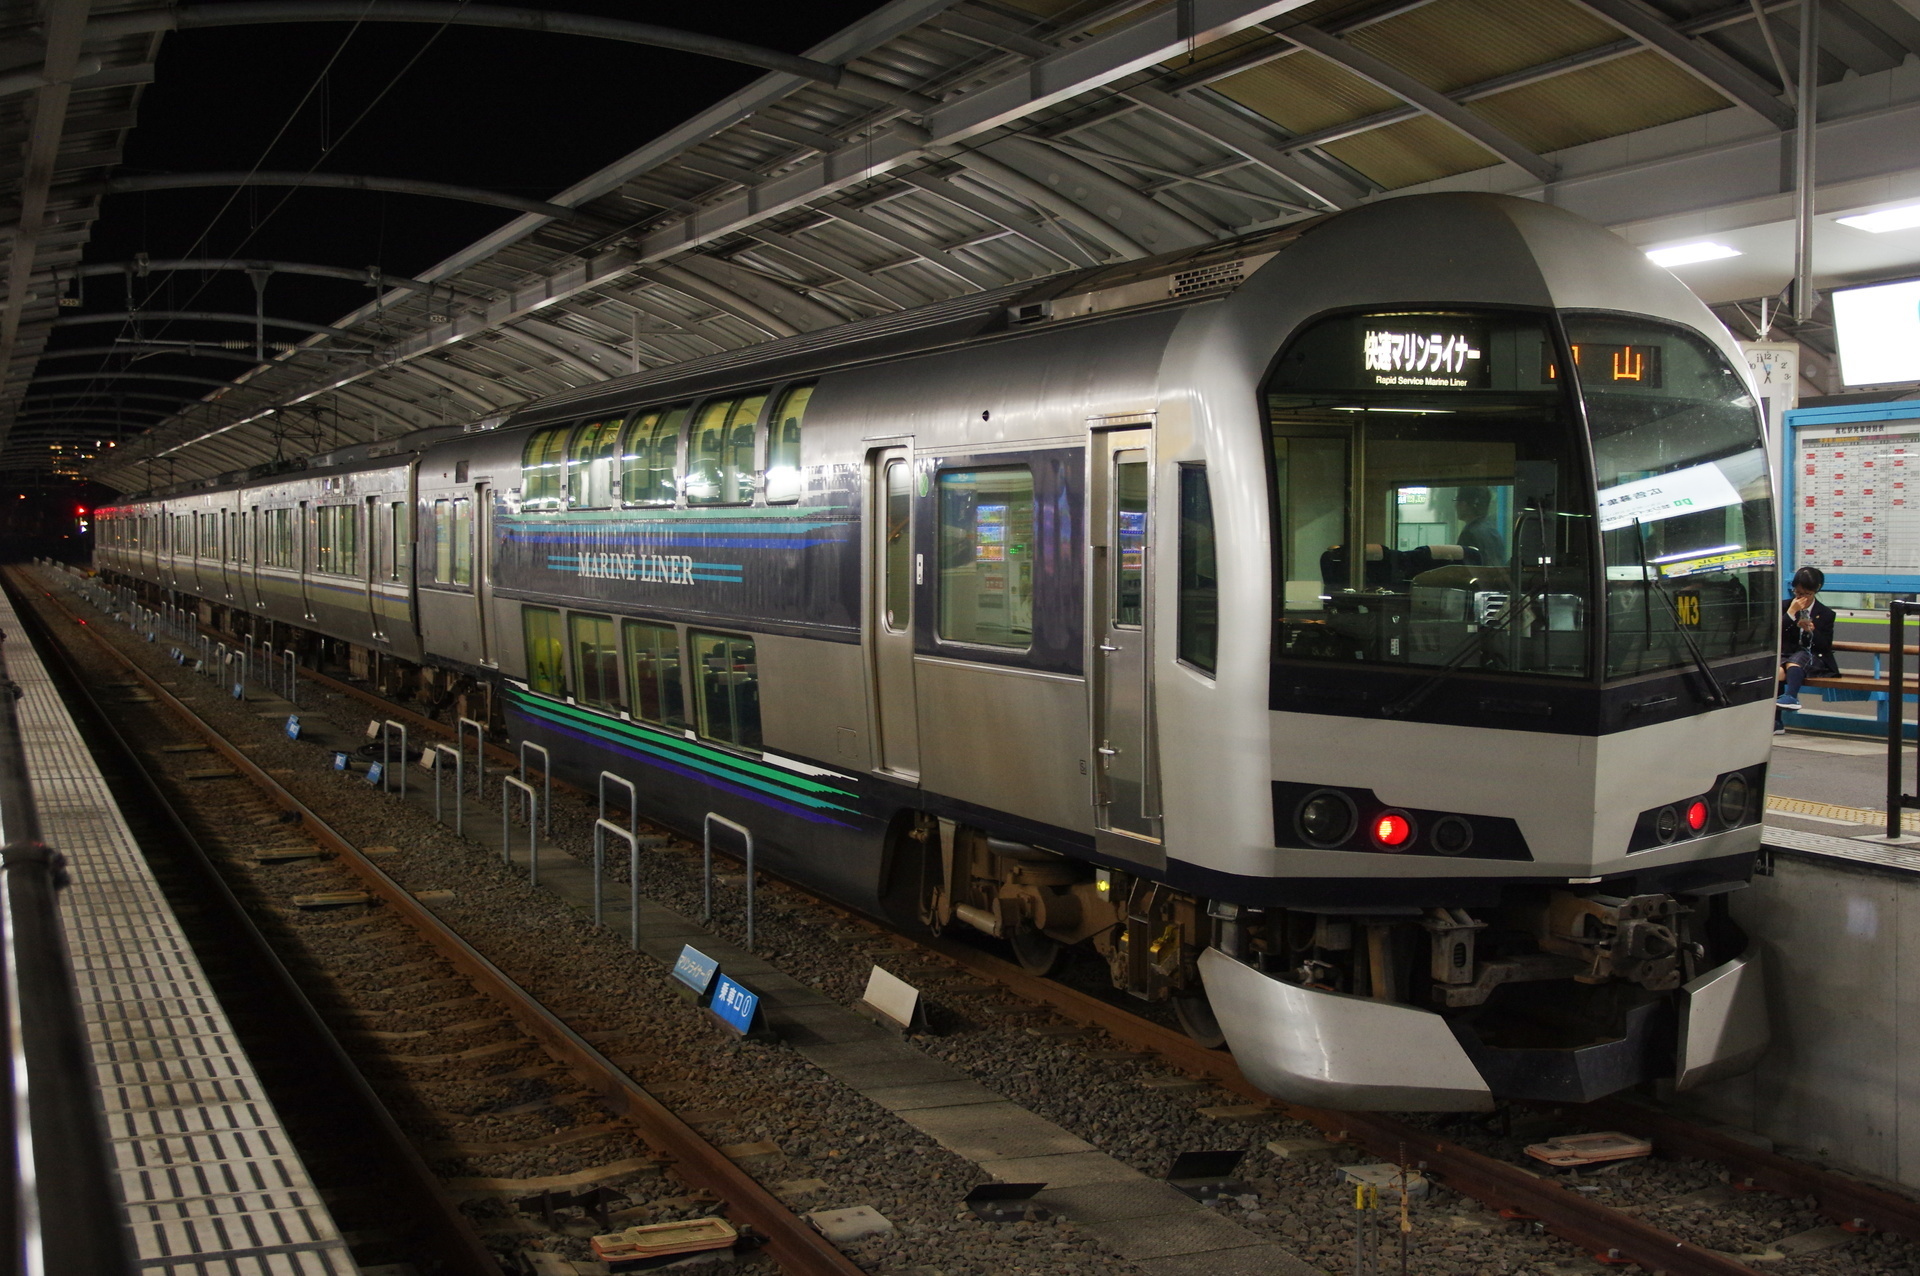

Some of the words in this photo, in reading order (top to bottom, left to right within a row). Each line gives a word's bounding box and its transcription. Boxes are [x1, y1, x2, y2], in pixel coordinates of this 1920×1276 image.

[1364, 331, 1480, 373] 快速マリンライナー
[1550, 345, 1641, 380] 山
[1376, 376, 1396, 385] Rapid
[1398, 376, 1424, 385] Service
[1425, 377, 1448, 386] Marine
[1450, 378, 1467, 386] Liner
[578, 552, 636, 581] MARINE
[641, 554, 695, 585] LINER
[1678, 596, 1699, 625] M3
[719, 982, 752, 1017] 乗車口①
